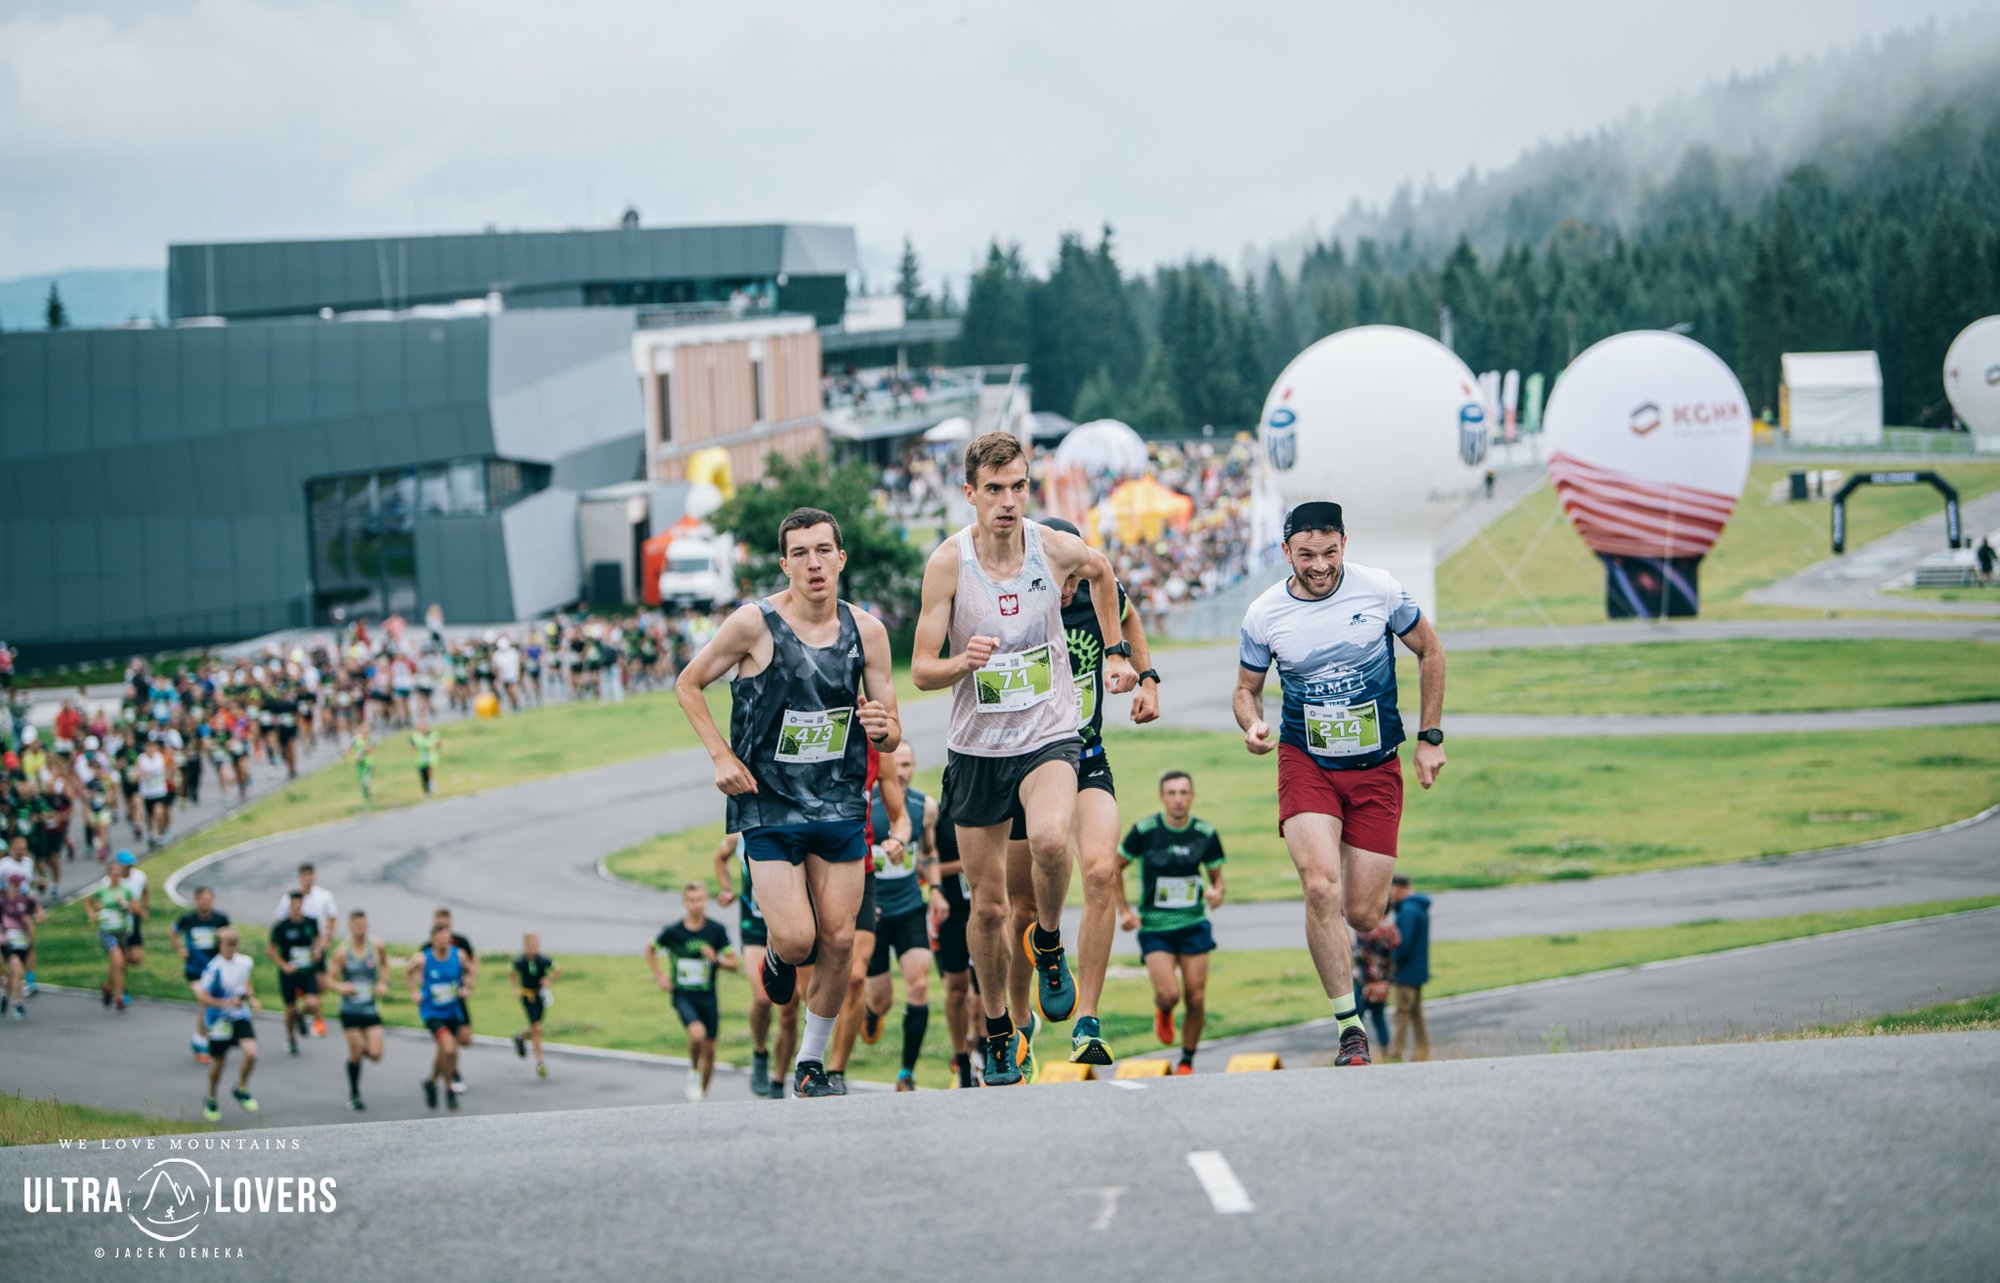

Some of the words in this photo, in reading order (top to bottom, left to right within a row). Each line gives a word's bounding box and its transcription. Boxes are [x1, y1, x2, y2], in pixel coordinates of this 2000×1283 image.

[998, 668, 1029, 690] 71
[1315, 677, 1355, 696] RMT
[795, 724, 834, 743] 473
[1319, 720, 1362, 737] 214
